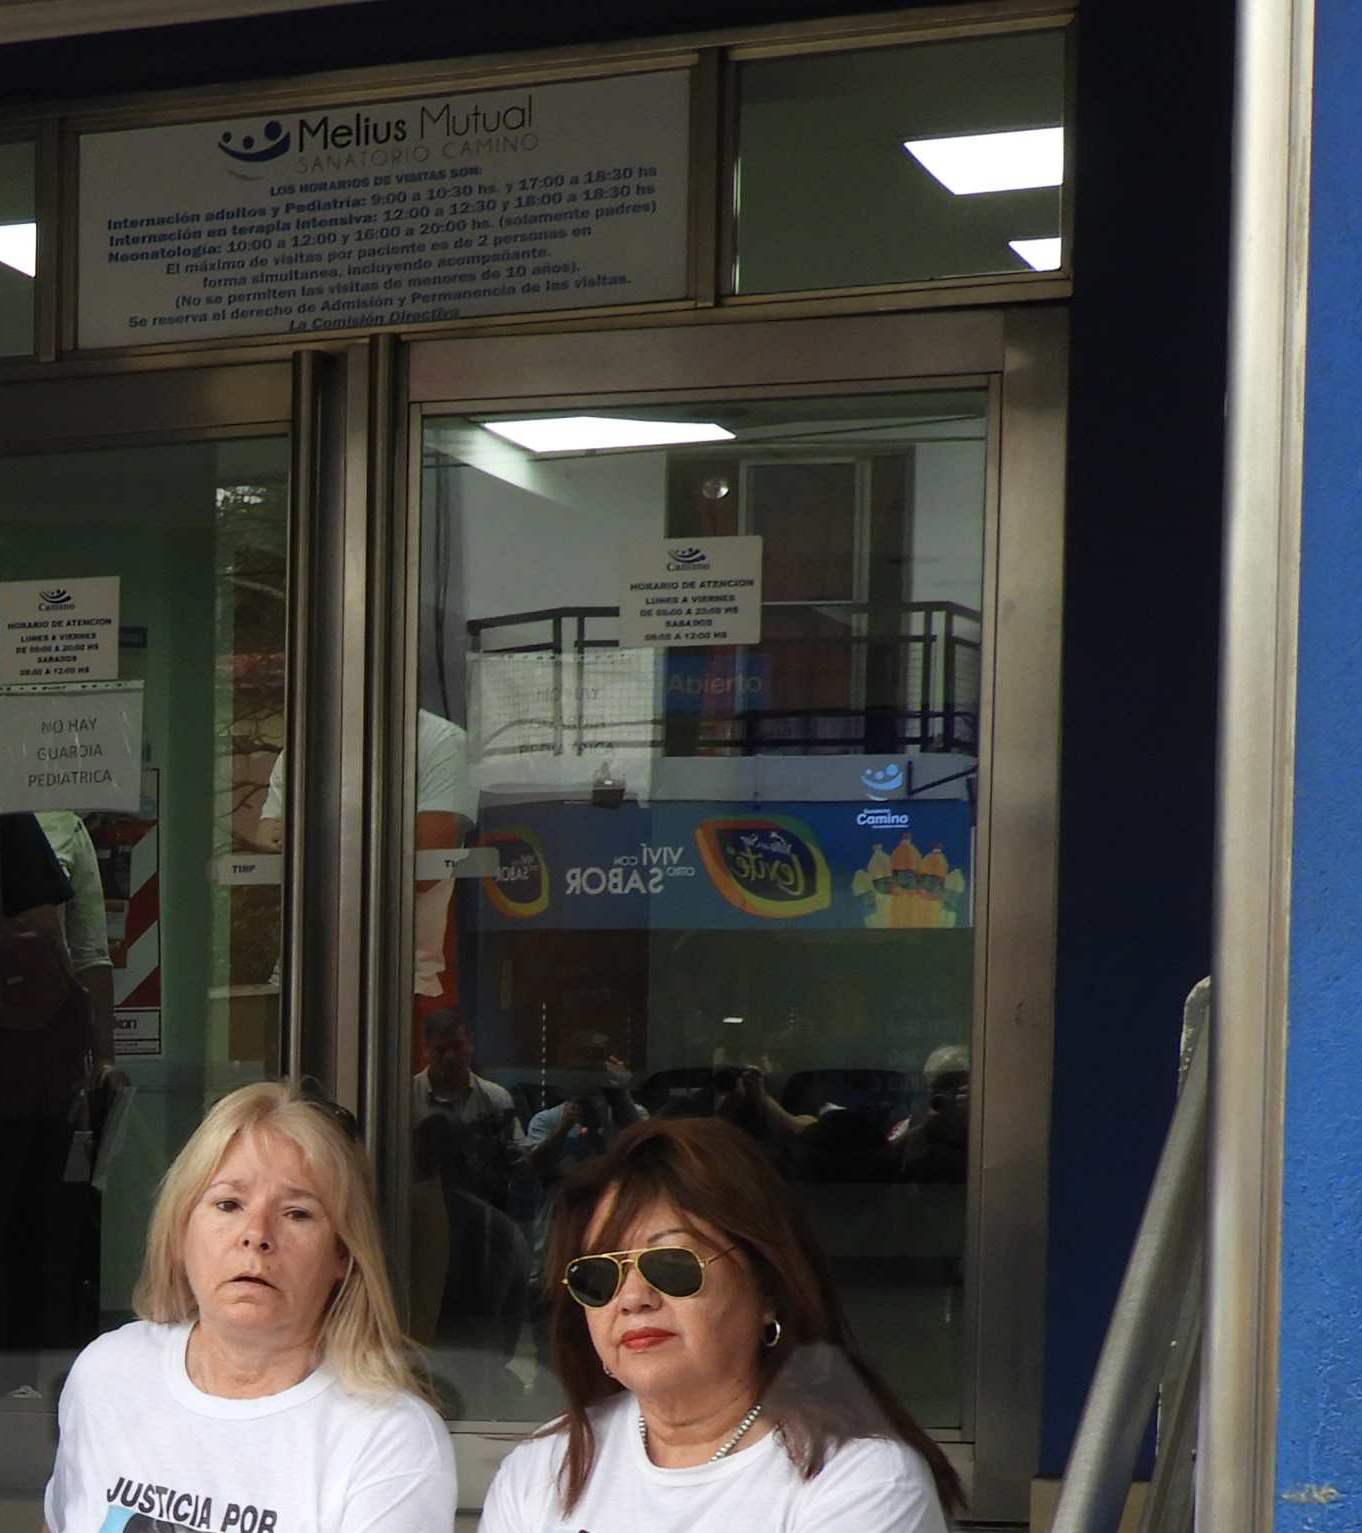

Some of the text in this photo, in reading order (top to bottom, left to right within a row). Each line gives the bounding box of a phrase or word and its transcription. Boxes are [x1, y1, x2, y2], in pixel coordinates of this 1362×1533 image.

[298, 94, 532, 152] Melius Mutual
[298, 133, 539, 173] SANATORIO CAMINO
[107, 211, 200, 230] Internación
[205, 204, 266, 222] adultos
[271, 207, 280, 219] y
[371, 191, 407, 206] 9:00
[412, 192, 421, 202] a
[427, 183, 473, 200] 10:30
[506, 183, 513, 194] y
[519, 174, 565, 190] 17:00
[569, 175, 579, 186] a
[585, 166, 634, 183] 18:30
[638, 165, 657, 178] hs
[270, 185, 295, 197] LOS
[299, 176, 369, 194] HORARIOS
[374, 175, 391, 186] DE
[395, 169, 446, 184] VISITAS
[109, 227, 202, 247] Internación
[207, 227, 227, 238] en
[232, 220, 290, 238] terapia
[296, 212, 378, 230] Intensiva:
[384, 207, 429, 223] 12:00
[434, 207, 444, 217] a
[449, 199, 496, 216] 12:30
[502, 200, 511, 213] y
[567, 193, 577, 203] a
[583, 184, 631, 201] 18:30
[635, 182, 655, 195] hs
[227, 238, 272, 253] 10:00
[277, 239, 285, 249] a
[291, 233, 337, 248] 12:00
[341, 233, 350, 246] y
[405, 227, 414, 237] a
[420, 219, 467, 235] 20:00
[499, 208, 590, 230] (solamente
[595, 201, 657, 221] padres)
[166, 226, 592, 275] El máximo de visitas por paciente es de 2 personas en
[175, 294, 200, 308] (No
[205, 294, 224, 305] se
[227, 286, 297, 305] permiten
[301, 285, 323, 297] las
[328, 281, 379, 295] visitas
[383, 278, 402, 290] de
[407, 273, 476, 289] menores
[481, 269, 500, 281] de
[507, 266, 525, 279] 10
[203, 275, 247, 289] forma
[347, 257, 433, 279] incluyendo
[129, 316, 147, 328] Se
[152, 314, 208, 328] reserva
[212, 310, 226, 322] el
[231, 304, 292, 320] derecho
[297, 303, 316, 315] de
[321, 292, 393, 313] Admisión
[398, 296, 406, 308] y
[411, 285, 517, 304] Permanencia
[521, 283, 540, 295] de
[546, 279, 569, 292] las
[289, 305, 460, 332] La Comisión Directiva
[630, 579, 754, 591] HORARIO DE ATENCION
[691, 594, 735, 603] VIERNES
[8, 618, 111, 630] HORARIO DE ATENCION
[41, 717, 98, 734] NO HAY
[36, 743, 103, 761] GUARDIA
[28, 769, 113, 788] PEDIATRICA
[857, 812, 909, 825] Camino
[106, 1476, 213, 1530] JUSTICIA
